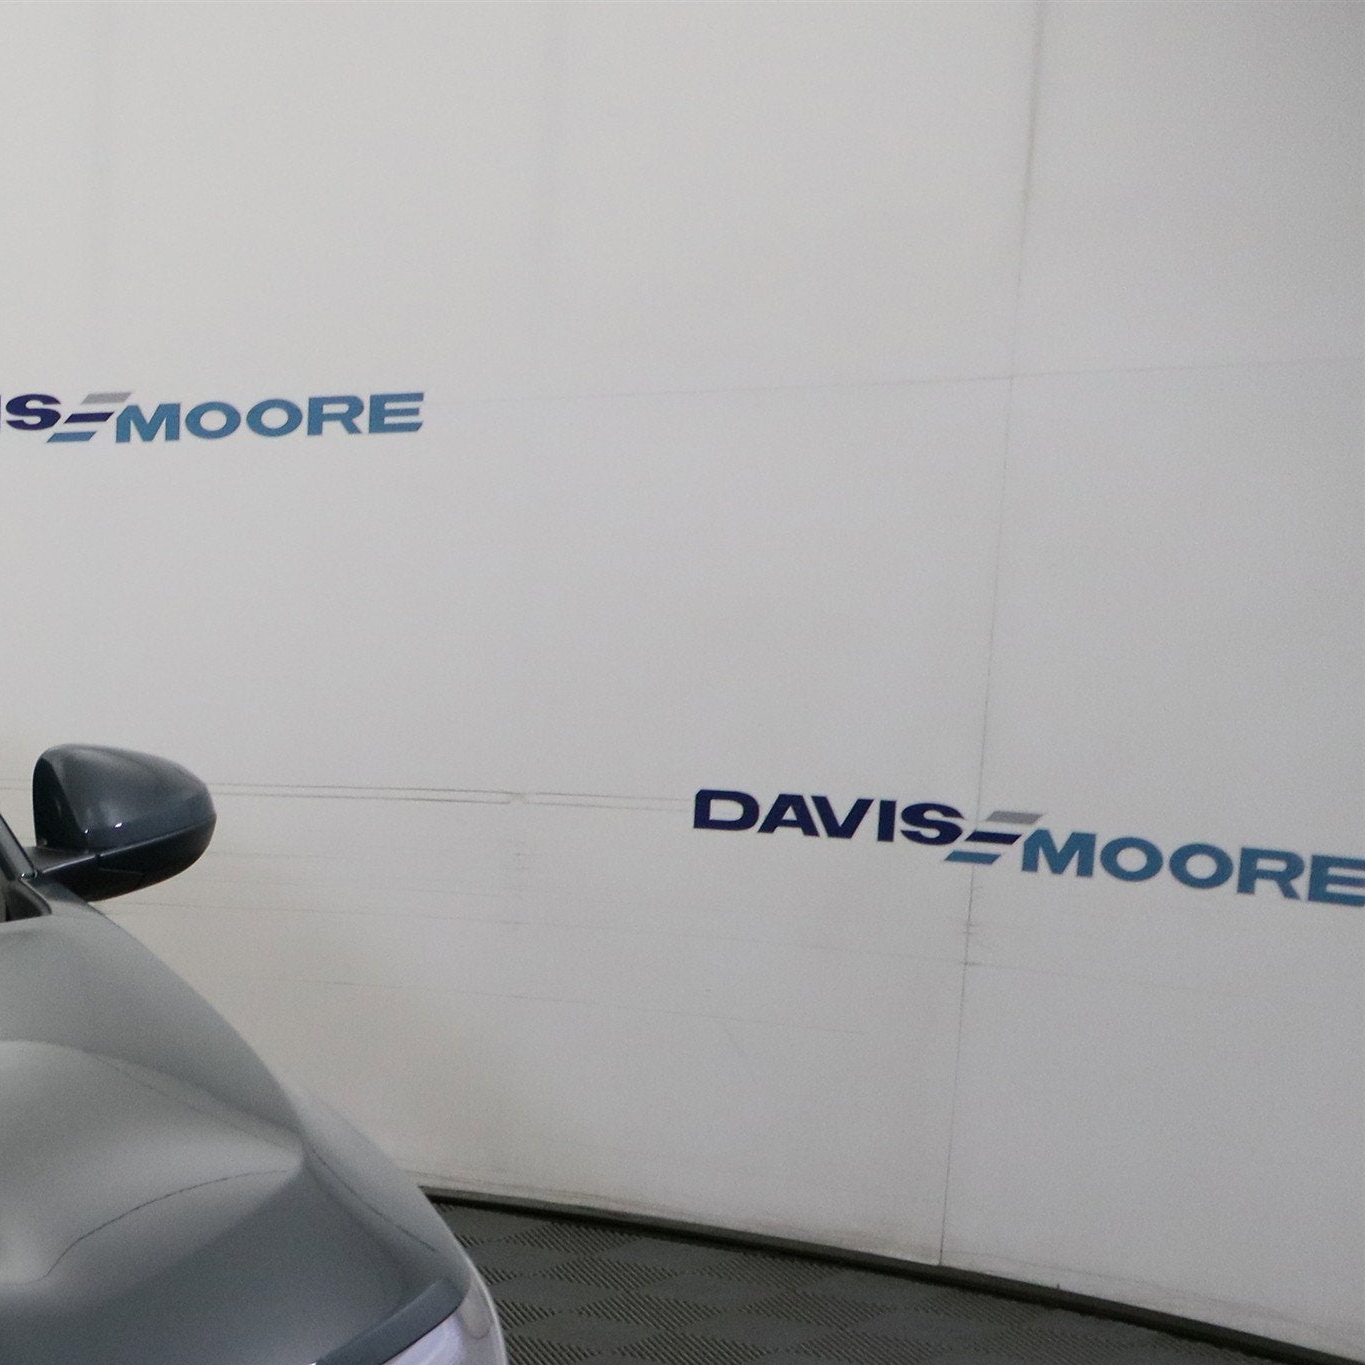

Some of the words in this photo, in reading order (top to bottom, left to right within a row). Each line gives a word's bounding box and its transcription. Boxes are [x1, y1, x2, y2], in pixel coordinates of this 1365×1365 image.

[116, 392, 425, 443] MOORE
[693, 788, 964, 846] DAVIS
[1021, 828, 1365, 909] MOORE
